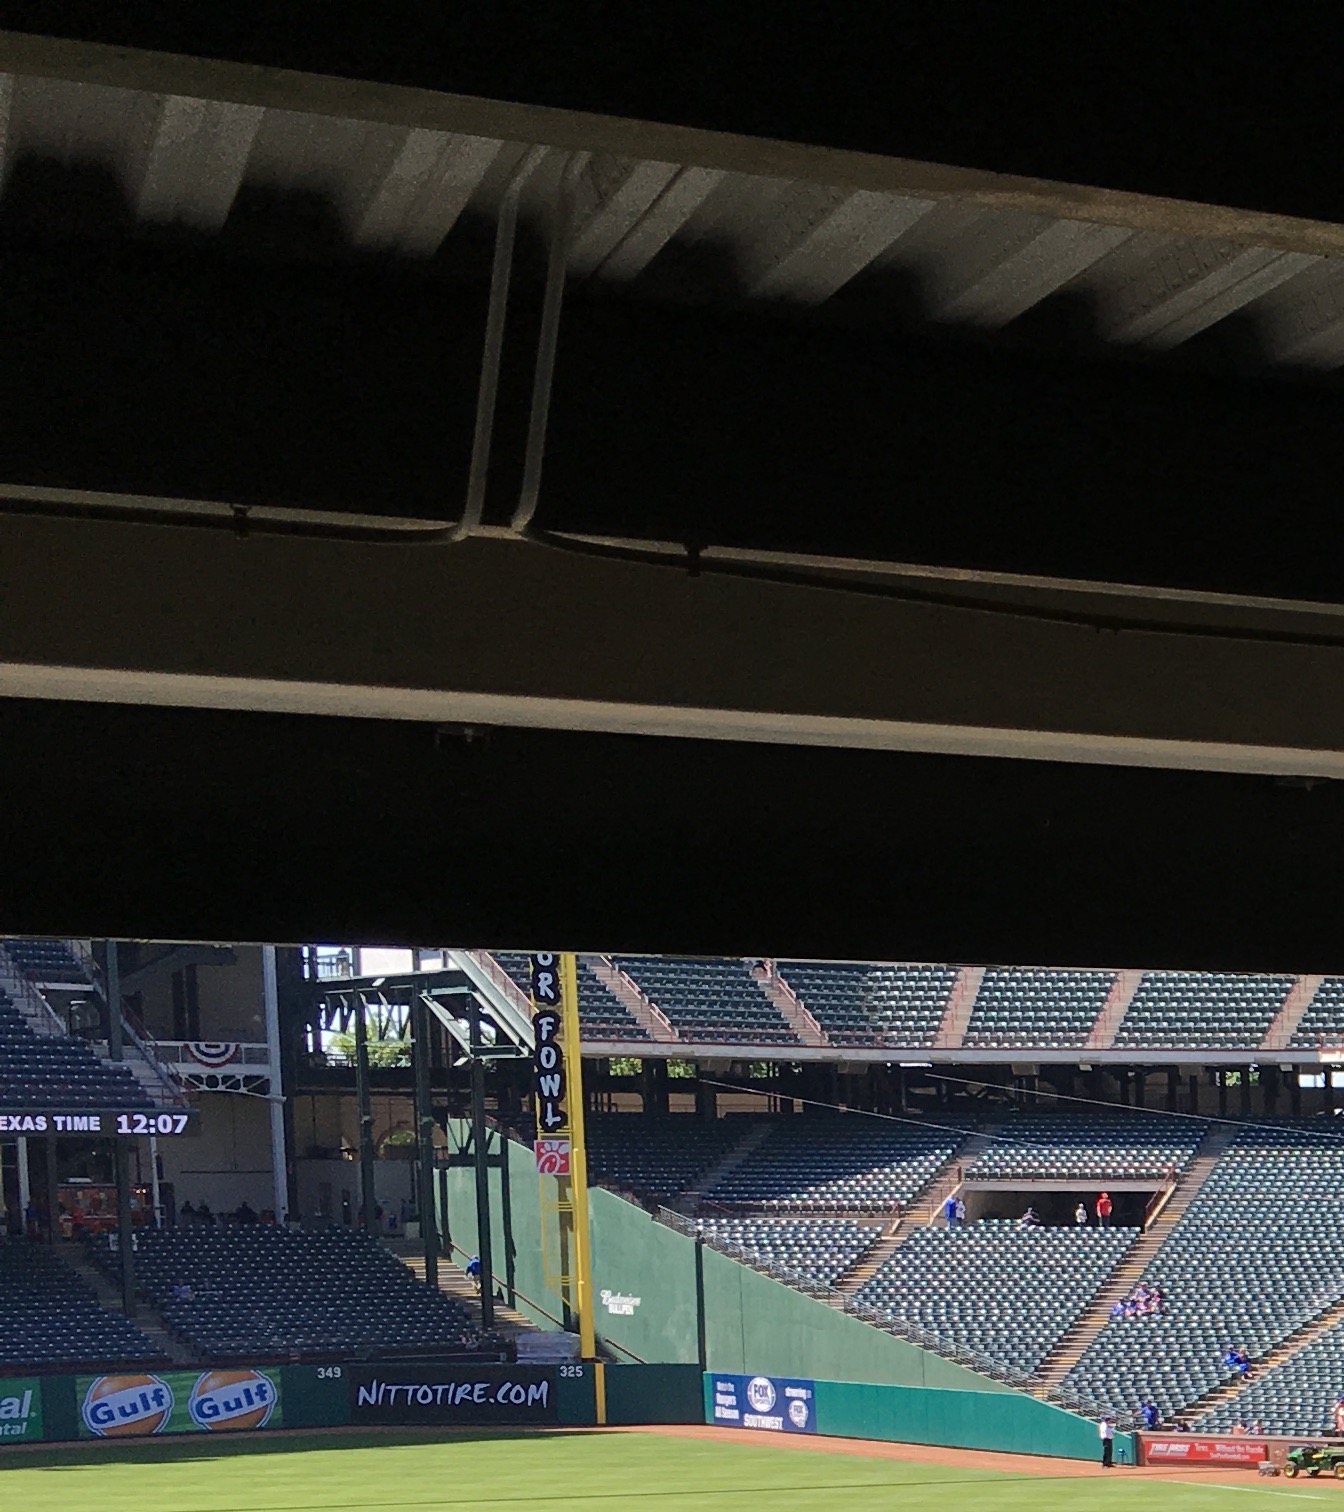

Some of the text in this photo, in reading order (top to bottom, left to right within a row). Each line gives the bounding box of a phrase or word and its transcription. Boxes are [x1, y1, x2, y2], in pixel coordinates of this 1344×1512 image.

[538, 1016, 561, 1127] FOWL
[53, 1116, 100, 1131] TIME
[117, 1114, 189, 1134] 12:07
[317, 1367, 342, 1379] 349
[560, 1366, 583, 1378] 325
[195, 1383, 268, 1419] Gulf
[357, 1378, 549, 1409] NITTOTIRE.COM
[754, 1384, 770, 1399] FOX
[90, 1387, 165, 1425] Gulf
